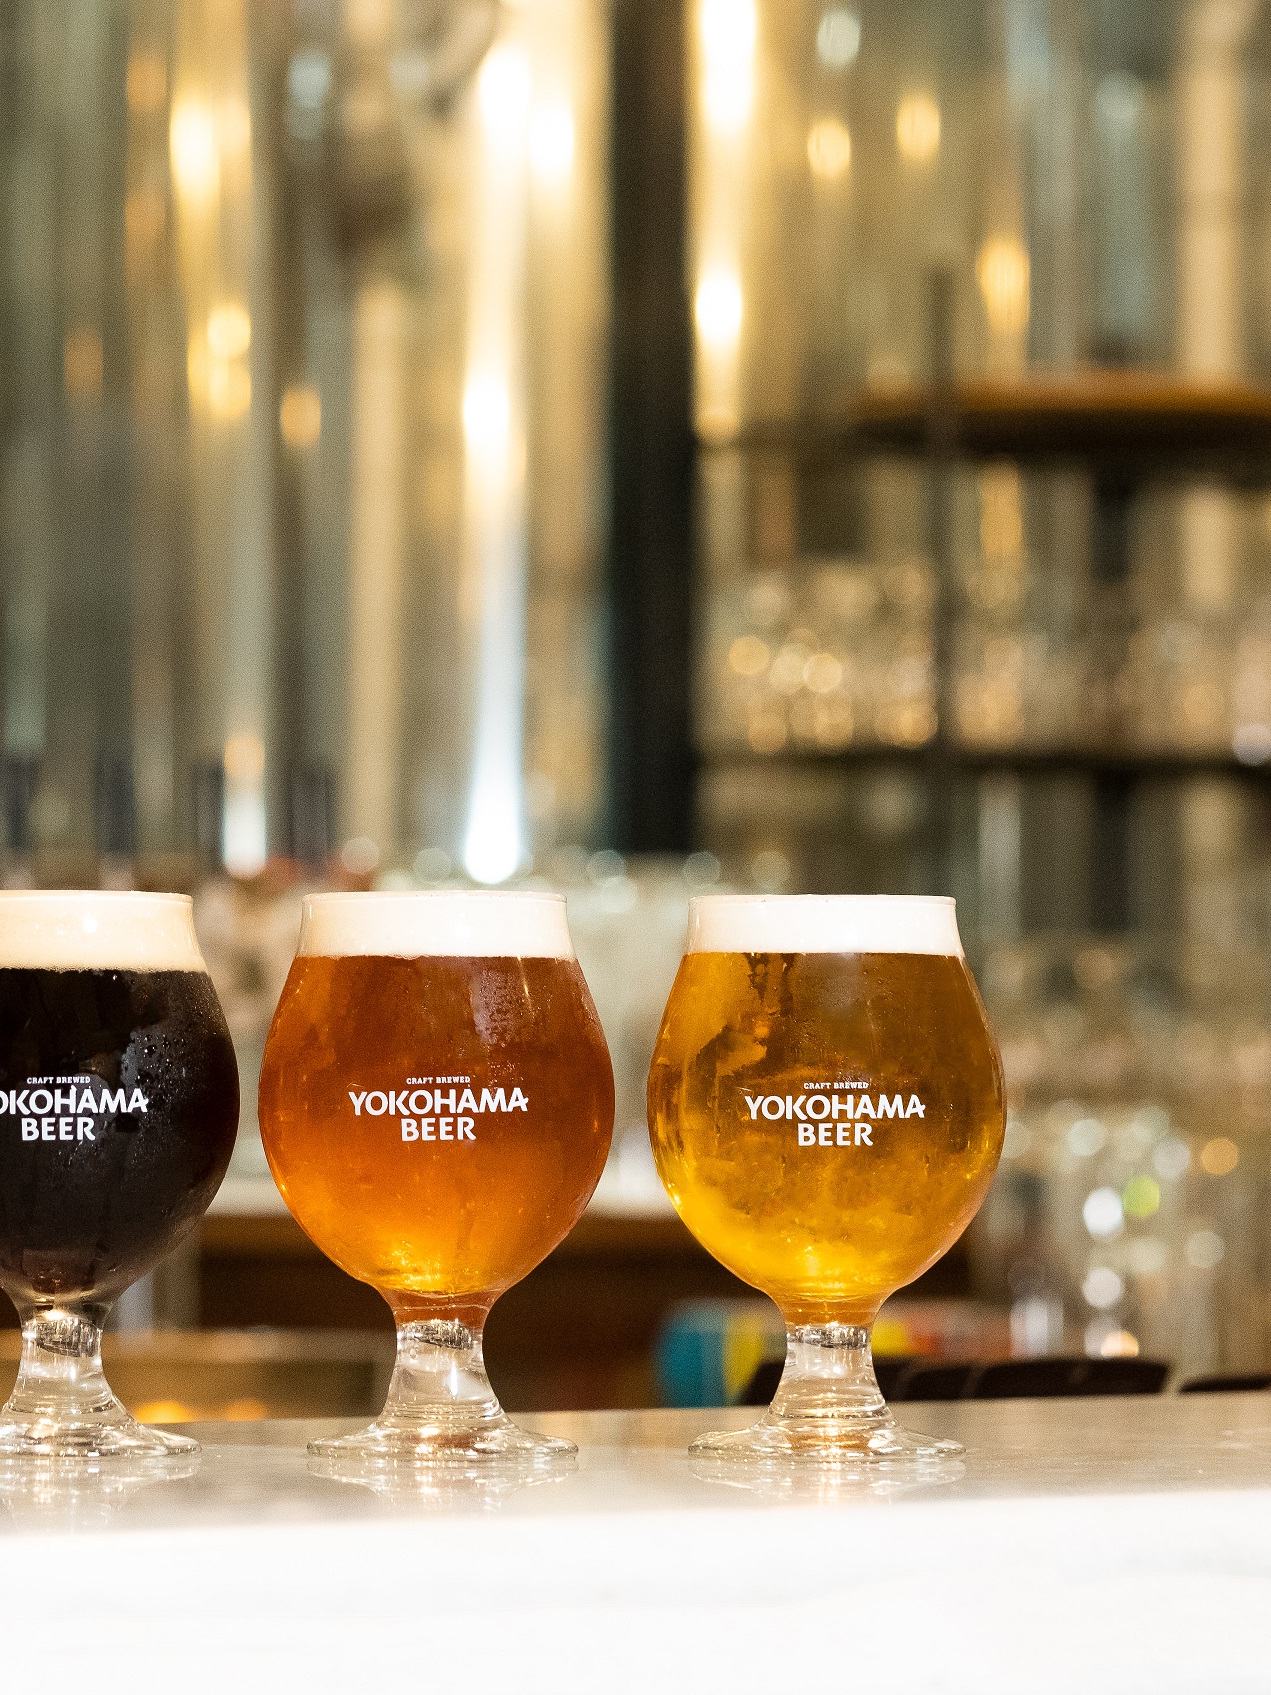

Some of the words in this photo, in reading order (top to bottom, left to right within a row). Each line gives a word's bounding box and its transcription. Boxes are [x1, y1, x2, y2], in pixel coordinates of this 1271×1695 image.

[26, 1076, 54, 1084] CRAFT
[56, 1076, 91, 1084] BREWED
[406, 1077, 434, 1085] CRAFT
[436, 1076, 471, 1084] BREWED
[803, 1082, 832, 1090] CRAFT
[833, 1081, 870, 1090] BREWED
[348, 1087, 529, 1116] YOKOHAMA
[744, 1094, 926, 1121] YOKOHAMA
[21, 1116, 96, 1141] BEER
[400, 1116, 477, 1142] BEER
[797, 1122, 874, 1147] BEER
